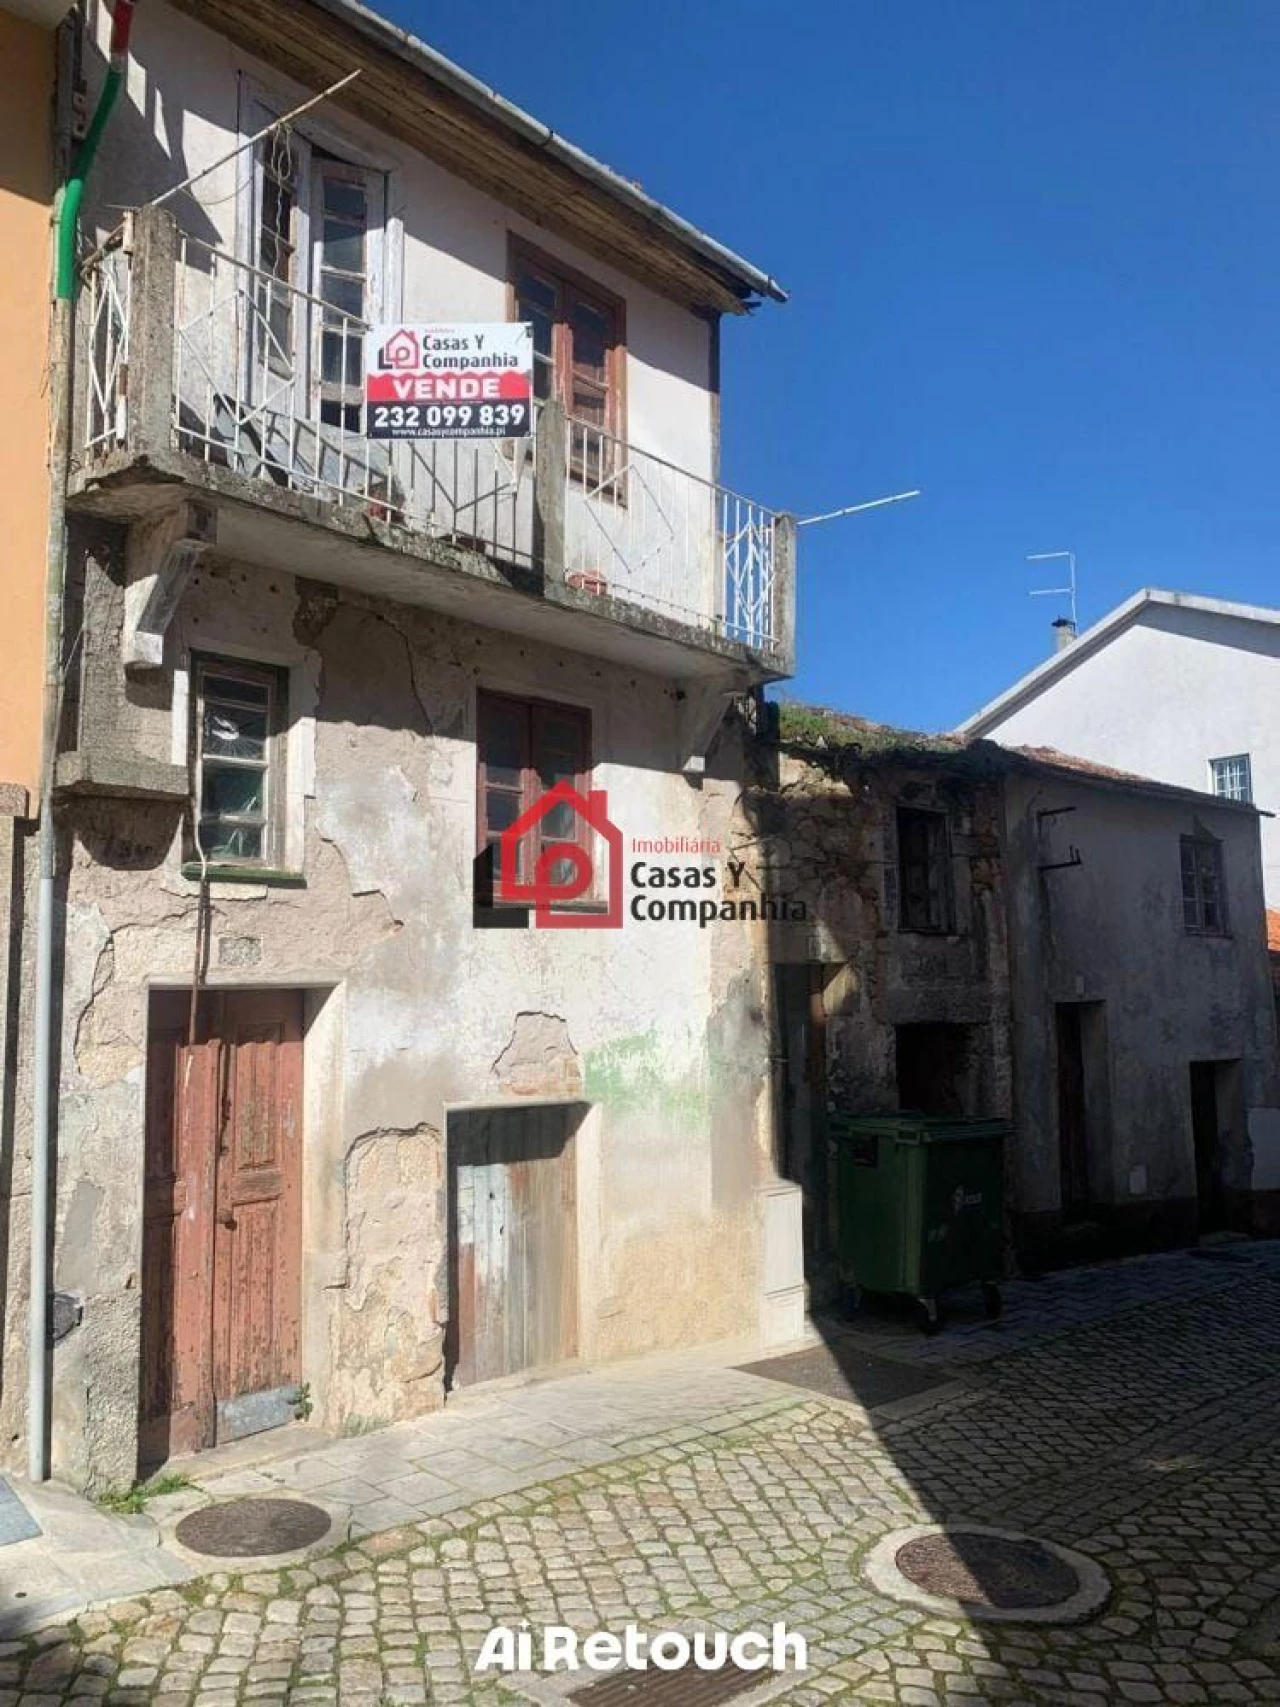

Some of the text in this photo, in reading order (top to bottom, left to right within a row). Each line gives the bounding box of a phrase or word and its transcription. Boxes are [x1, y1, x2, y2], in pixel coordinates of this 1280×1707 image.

[423, 334, 485, 350] Casas Y
[423, 353, 518, 370] Companhia
[393, 378, 500, 399] VENDE
[375, 404, 525, 428] 232 099 839
